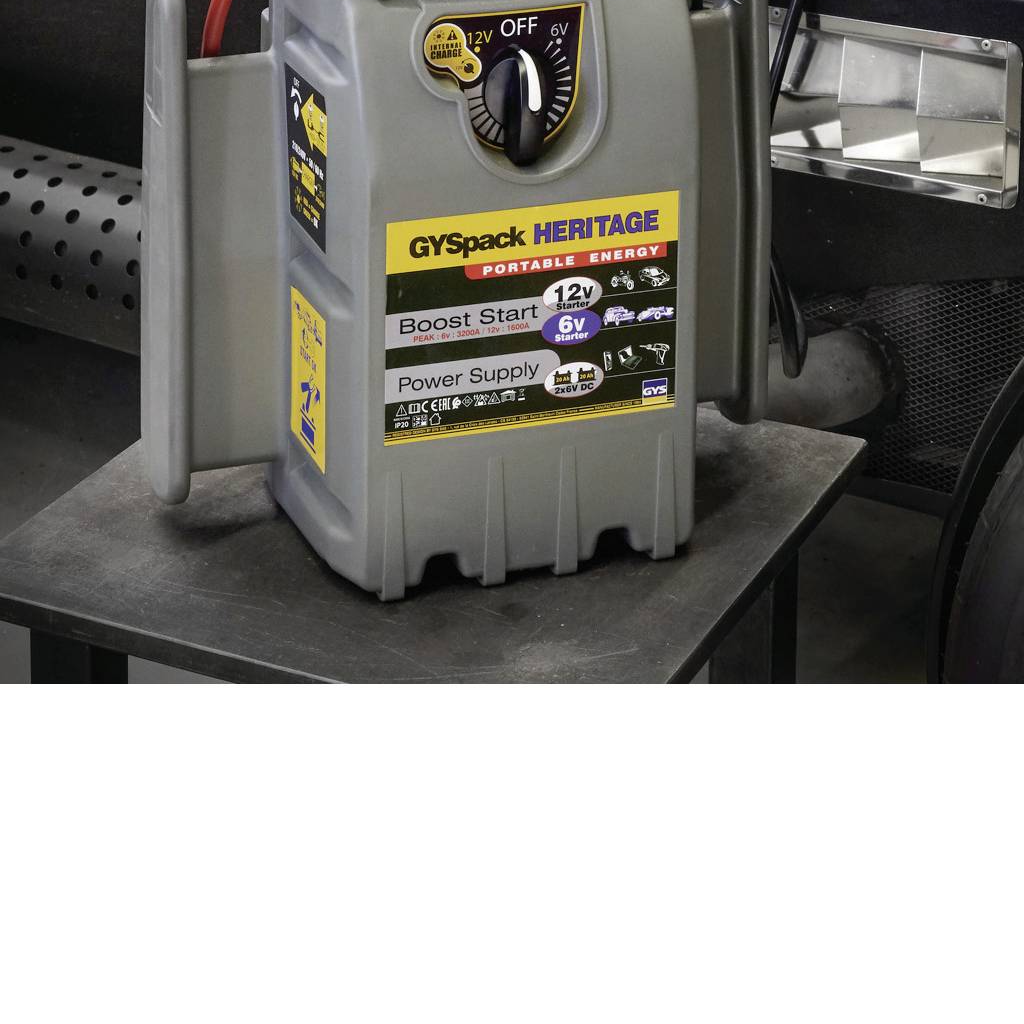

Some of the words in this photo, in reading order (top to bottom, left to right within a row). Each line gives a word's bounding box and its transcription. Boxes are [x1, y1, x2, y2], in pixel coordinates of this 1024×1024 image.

[500, 16, 538, 37] OFF
[551, 22, 568, 37] 6V
[467, 30, 493, 45] 12V
[430, 42, 462, 51] INTERNAL
[430, 48, 462, 60] CHARGE
[409, 226, 526, 258] GYSpack
[534, 209, 659, 245] HERITAGE
[483, 256, 575, 275] PORTABLE
[590, 246, 660, 263] ENERGY
[554, 284, 593, 302] 12v
[556, 300, 589, 311] Starter
[400, 312, 471, 334] Boost
[480, 304, 538, 324] Start
[558, 315, 585, 333] 6v
[413, 334, 434, 343] PEAK
[457, 329, 480, 337] 3200A
[555, 330, 588, 342] Starter
[399, 372, 463, 392] Power
[469, 361, 540, 384] Supply
[555, 385, 578, 394] 2x6V
[581, 383, 594, 391] DC
[643, 387, 667, 395] GYS
